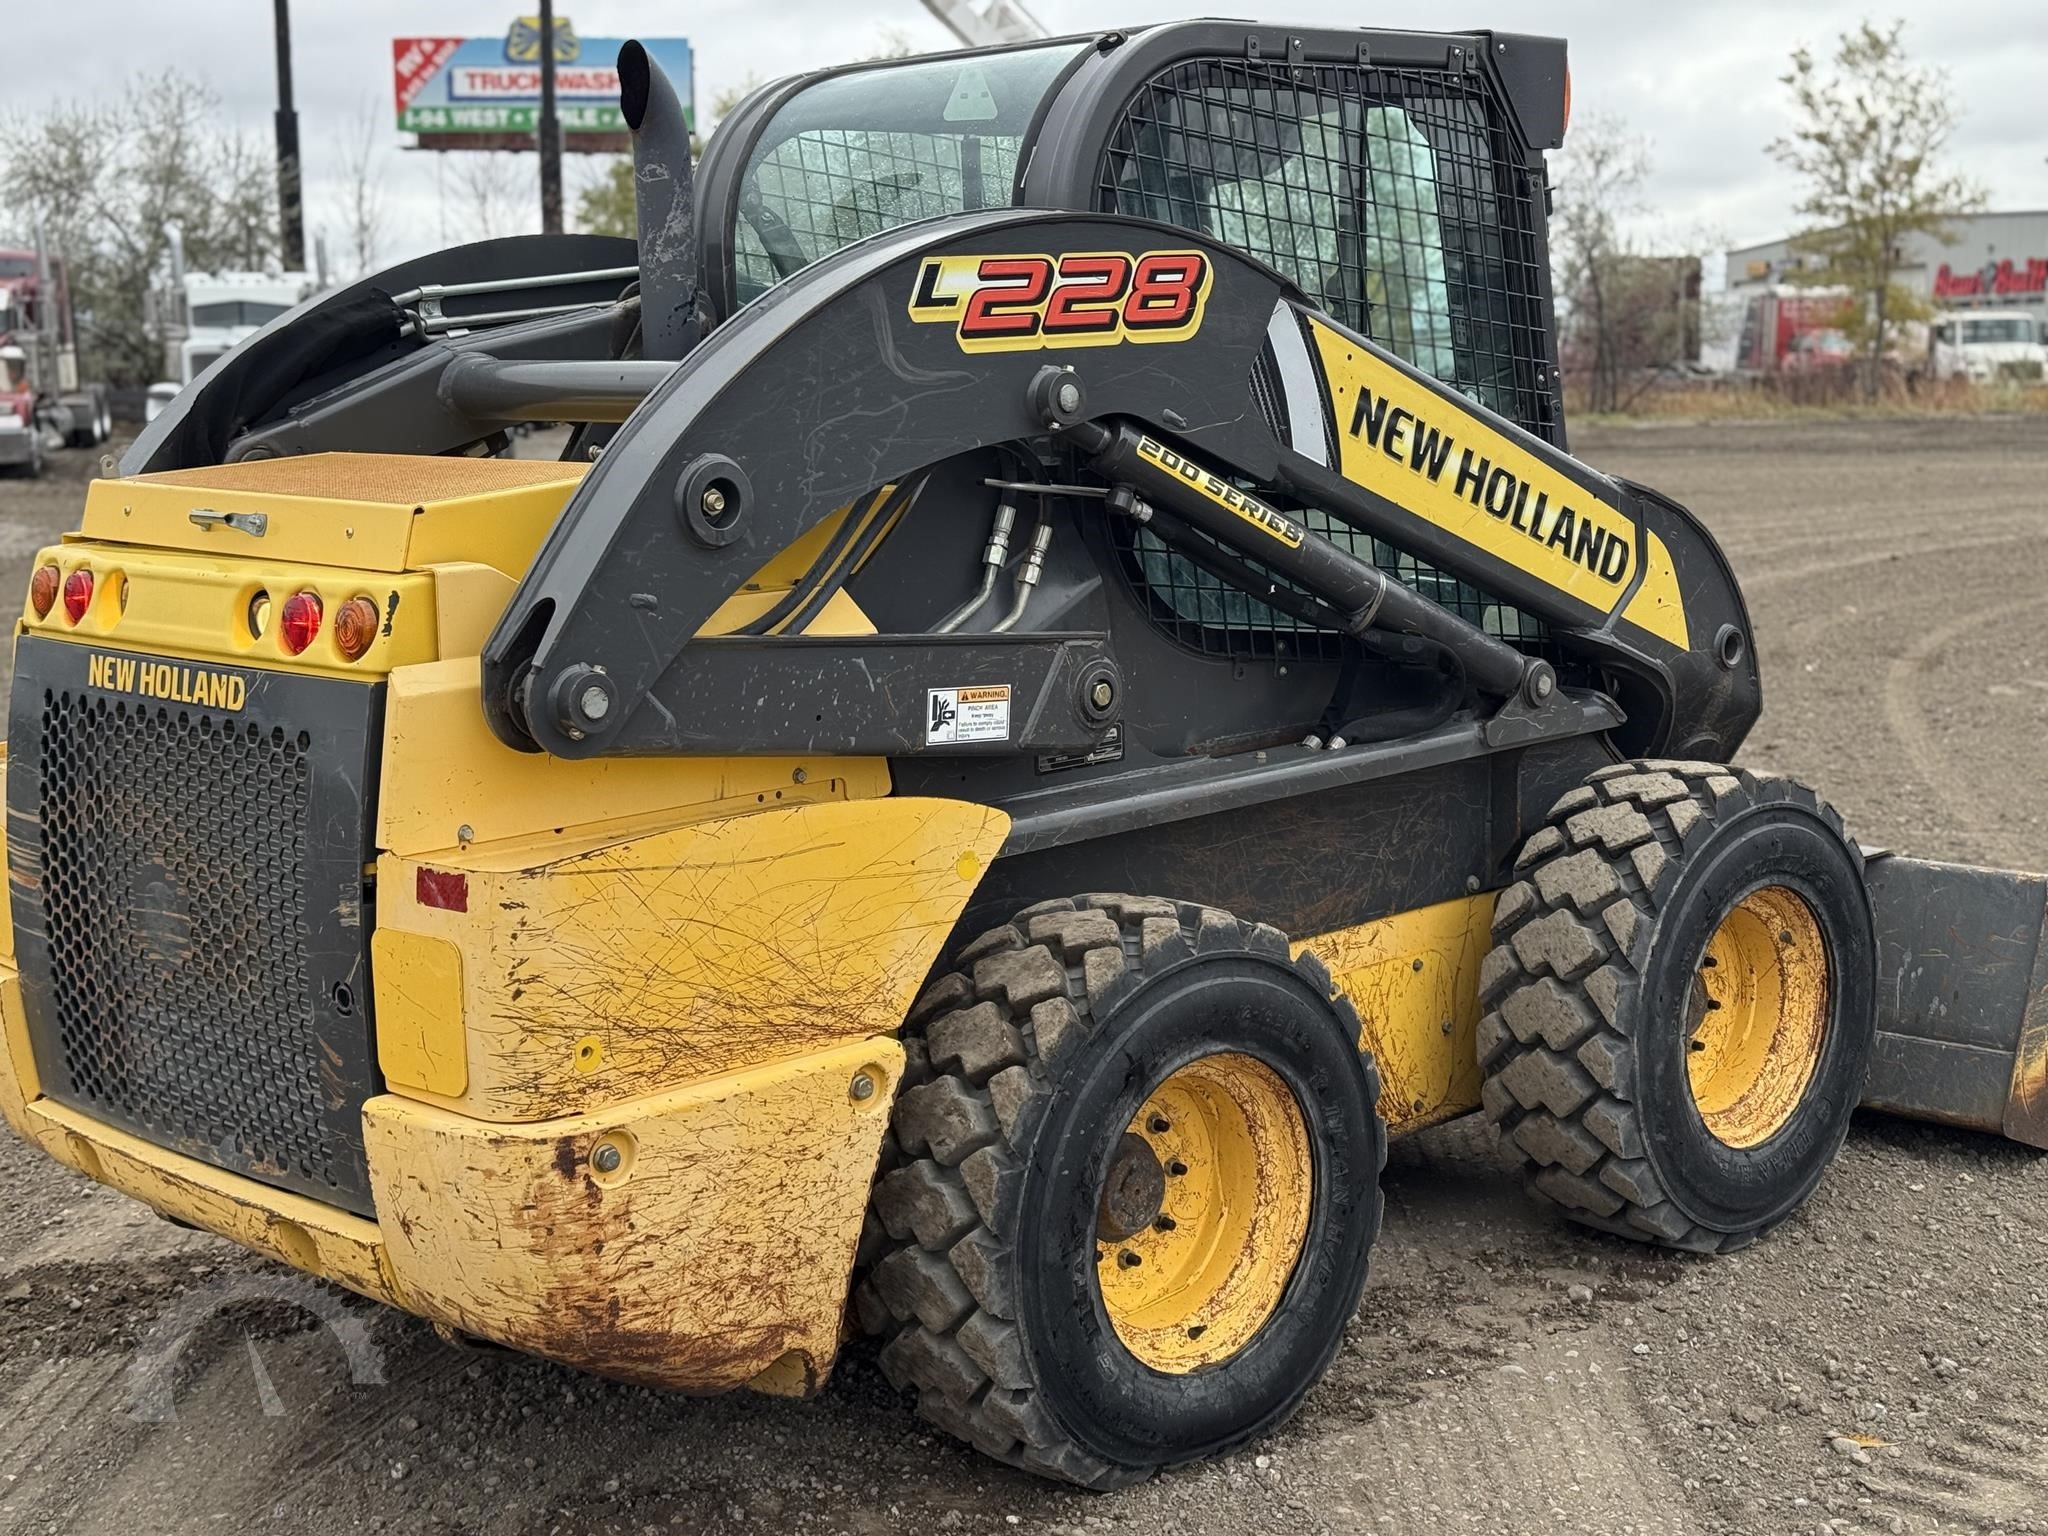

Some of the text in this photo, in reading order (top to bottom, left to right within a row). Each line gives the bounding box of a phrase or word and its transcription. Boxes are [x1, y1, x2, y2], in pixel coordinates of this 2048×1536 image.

[451, 108, 508, 128] WEST
[1138, 441, 1304, 544] 200 SERIES
[1349, 384, 1631, 585] NEW HOLLAND
[87, 653, 246, 712] NEW HOLLAND
